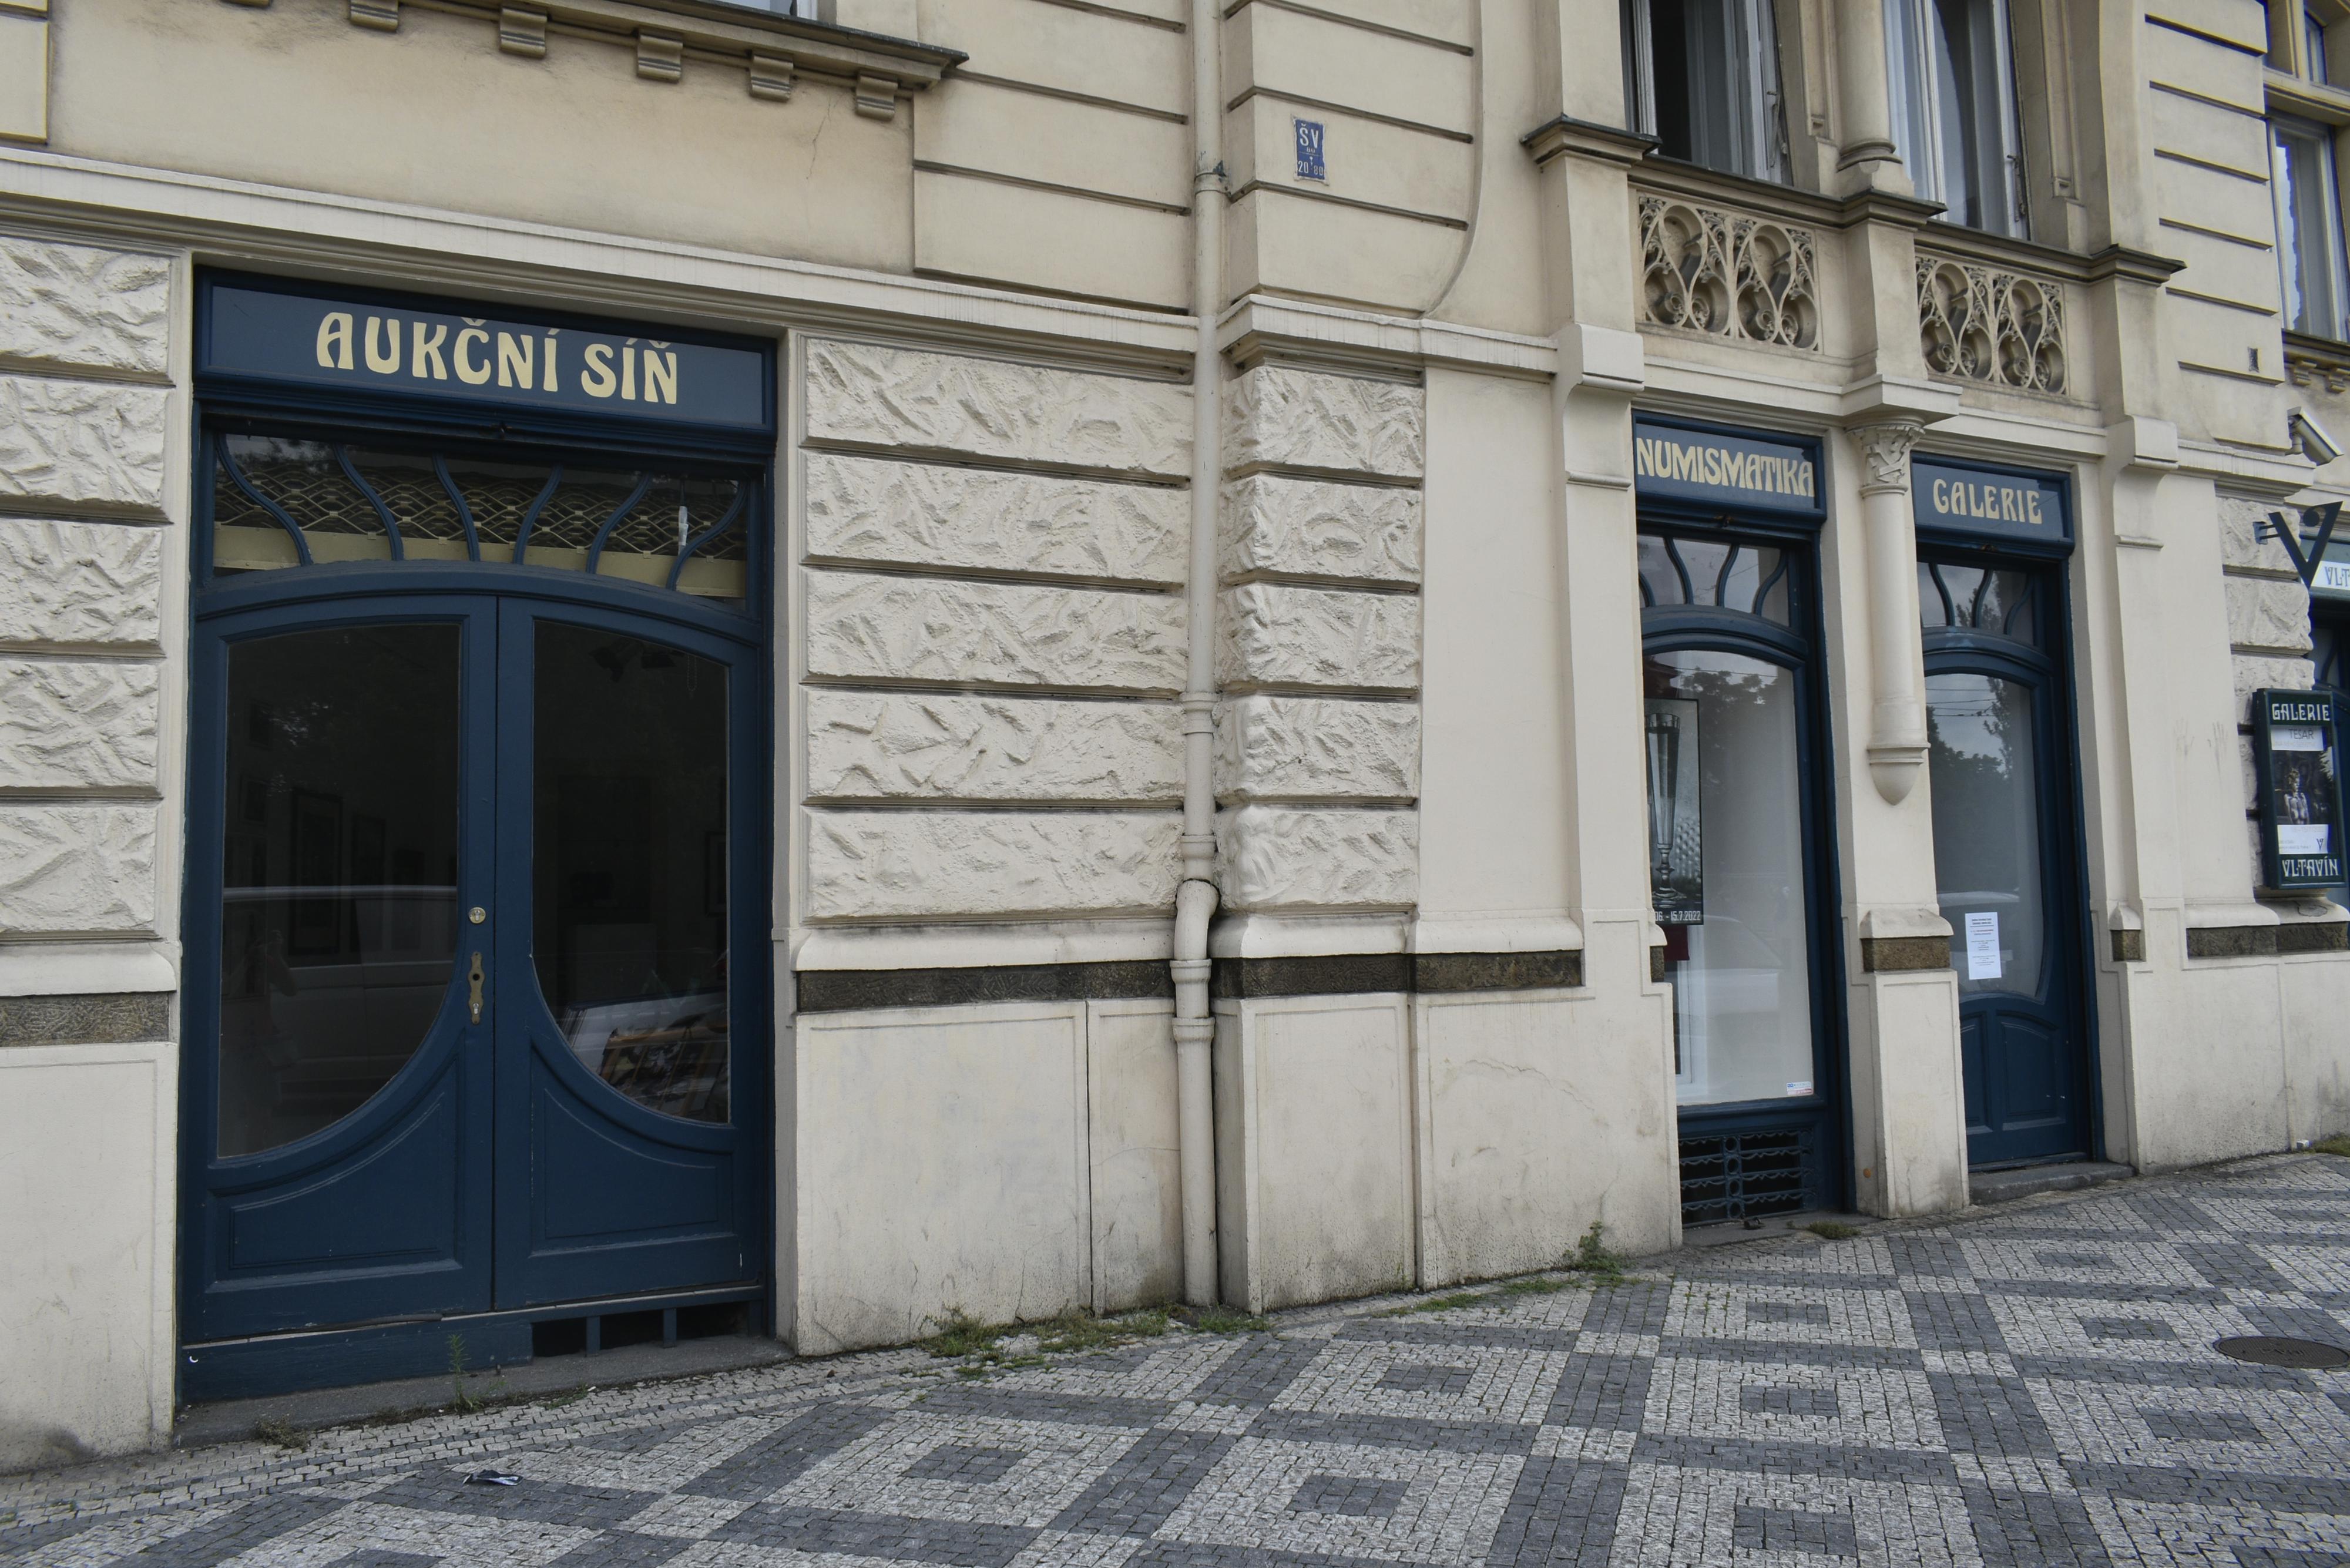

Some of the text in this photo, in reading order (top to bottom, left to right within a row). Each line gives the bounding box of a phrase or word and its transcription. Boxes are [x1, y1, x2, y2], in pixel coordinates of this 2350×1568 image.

[1300, 123, 1318, 148] ŠV
[316, 312, 677, 404] AUKČNÍ SÍŇ
[1636, 437, 1815, 498] NUMISMATIKA
[1932, 478, 2043, 525] GALERIE
[2272, 703, 2330, 721] GALERIE
[2282, 856, 2339, 877] VLTAVÍN
